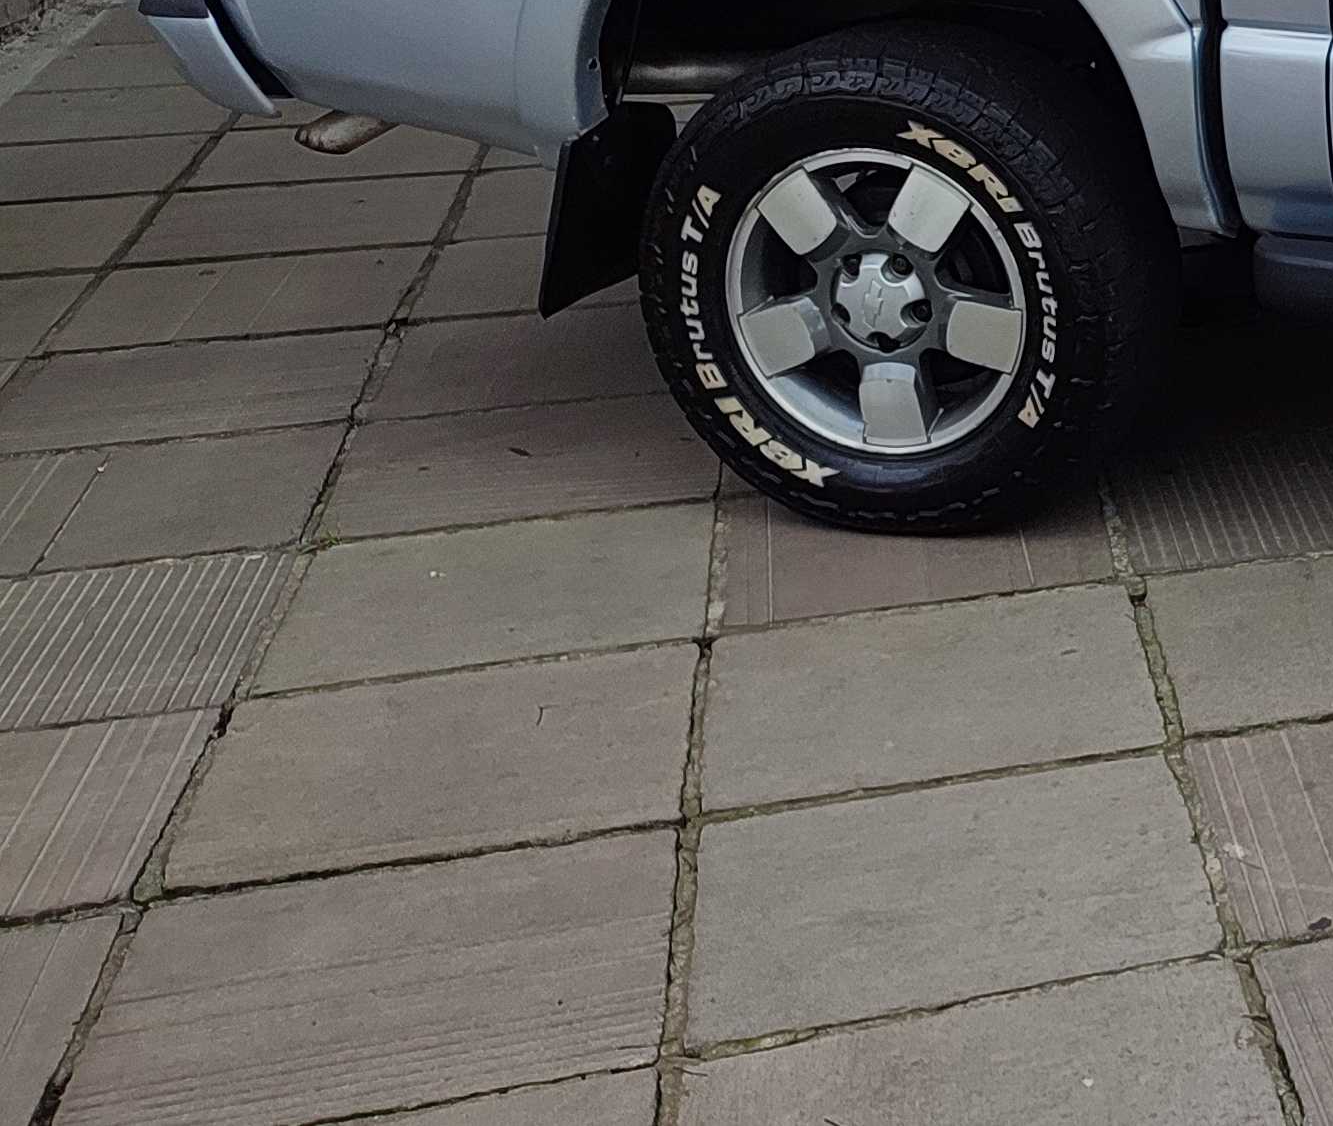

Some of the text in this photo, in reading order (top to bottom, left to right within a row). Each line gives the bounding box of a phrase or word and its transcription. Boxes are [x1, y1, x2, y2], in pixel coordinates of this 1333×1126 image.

[679, 185, 840, 487] XBRI Brutus T/A
[896, 120, 1060, 429] XBRI Brutus T/A
